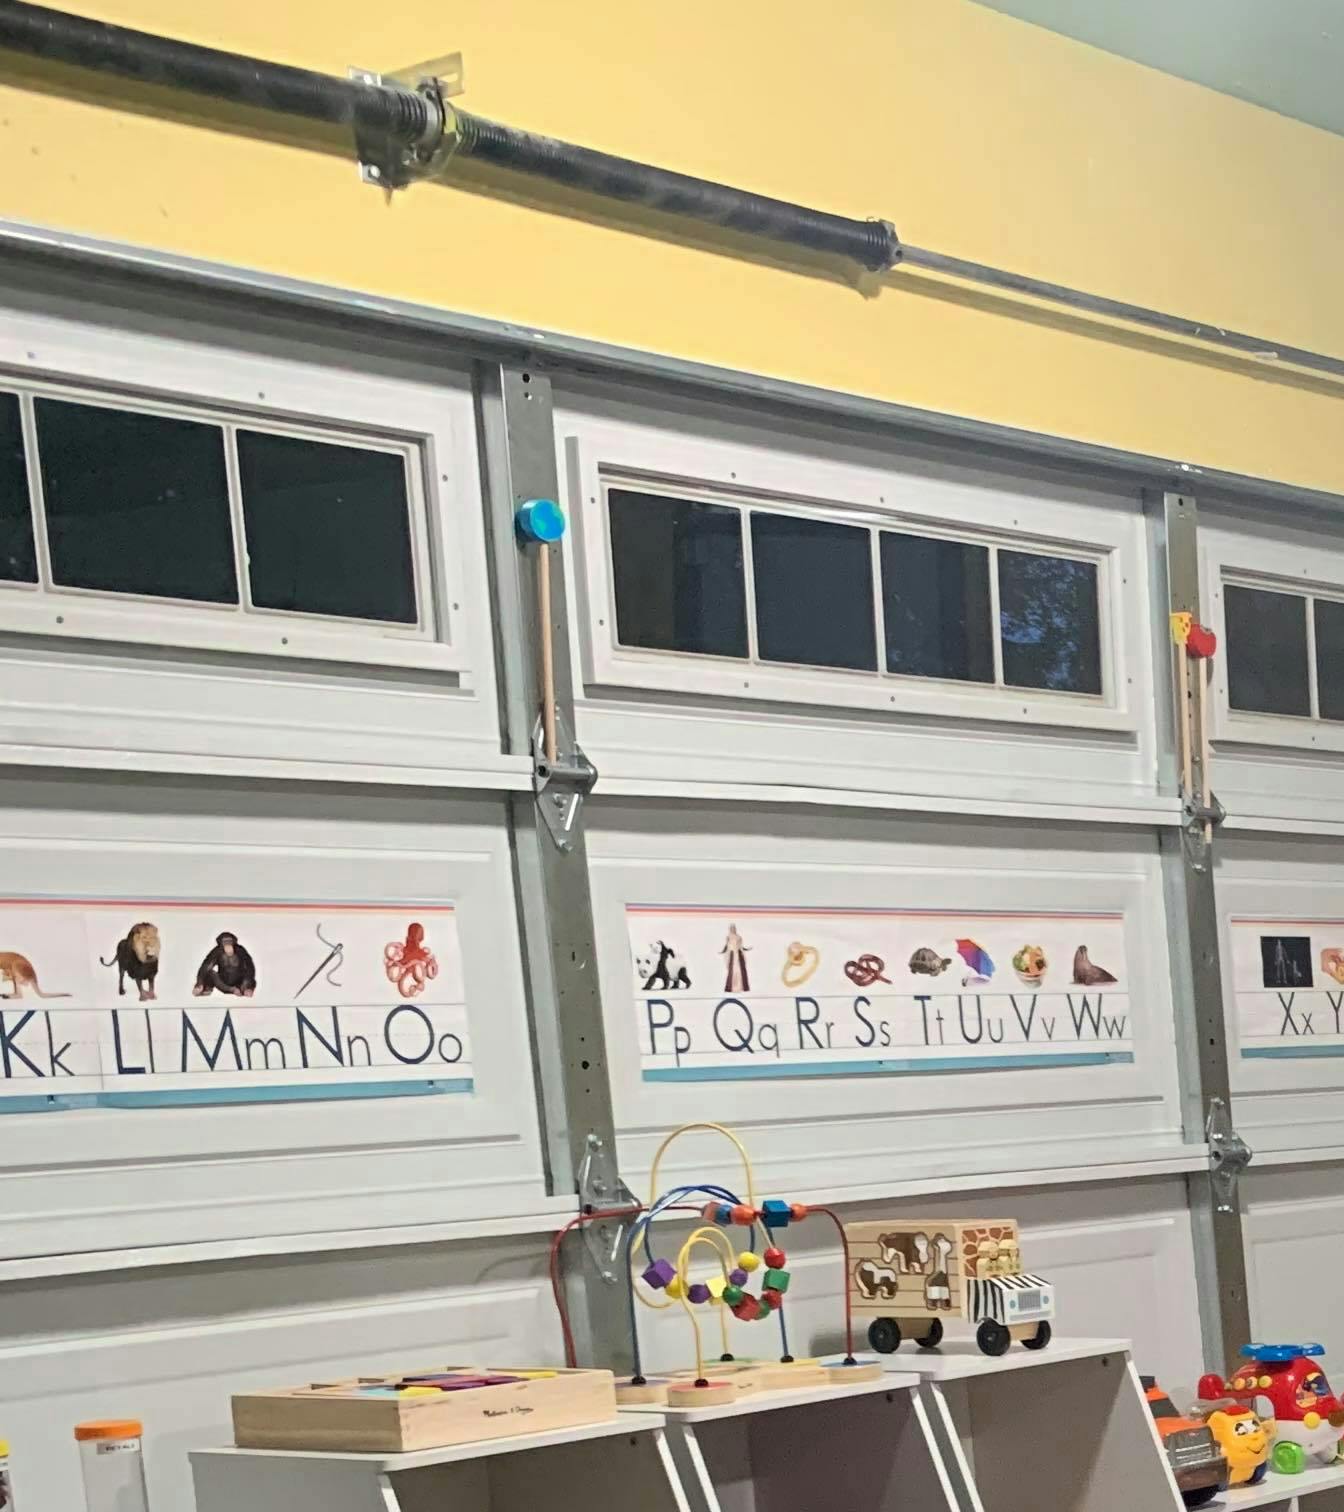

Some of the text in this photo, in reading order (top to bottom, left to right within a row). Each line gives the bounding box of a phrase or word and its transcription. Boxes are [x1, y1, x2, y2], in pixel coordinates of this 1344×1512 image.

[181, 1009, 287, 1073] Mm
[295, 1005, 372, 1069] Nn
[383, 1004, 463, 1065] Oo
[646, 998, 692, 1067] Pp
[711, 997, 781, 1059] Qq
[794, 996, 836, 1050] Rr
[852, 995, 892, 1048] Ss
[1008, 993, 1056, 1041] Vv
[1065, 992, 1127, 1040] Ww
[1277, 991, 1316, 1036] Xx
